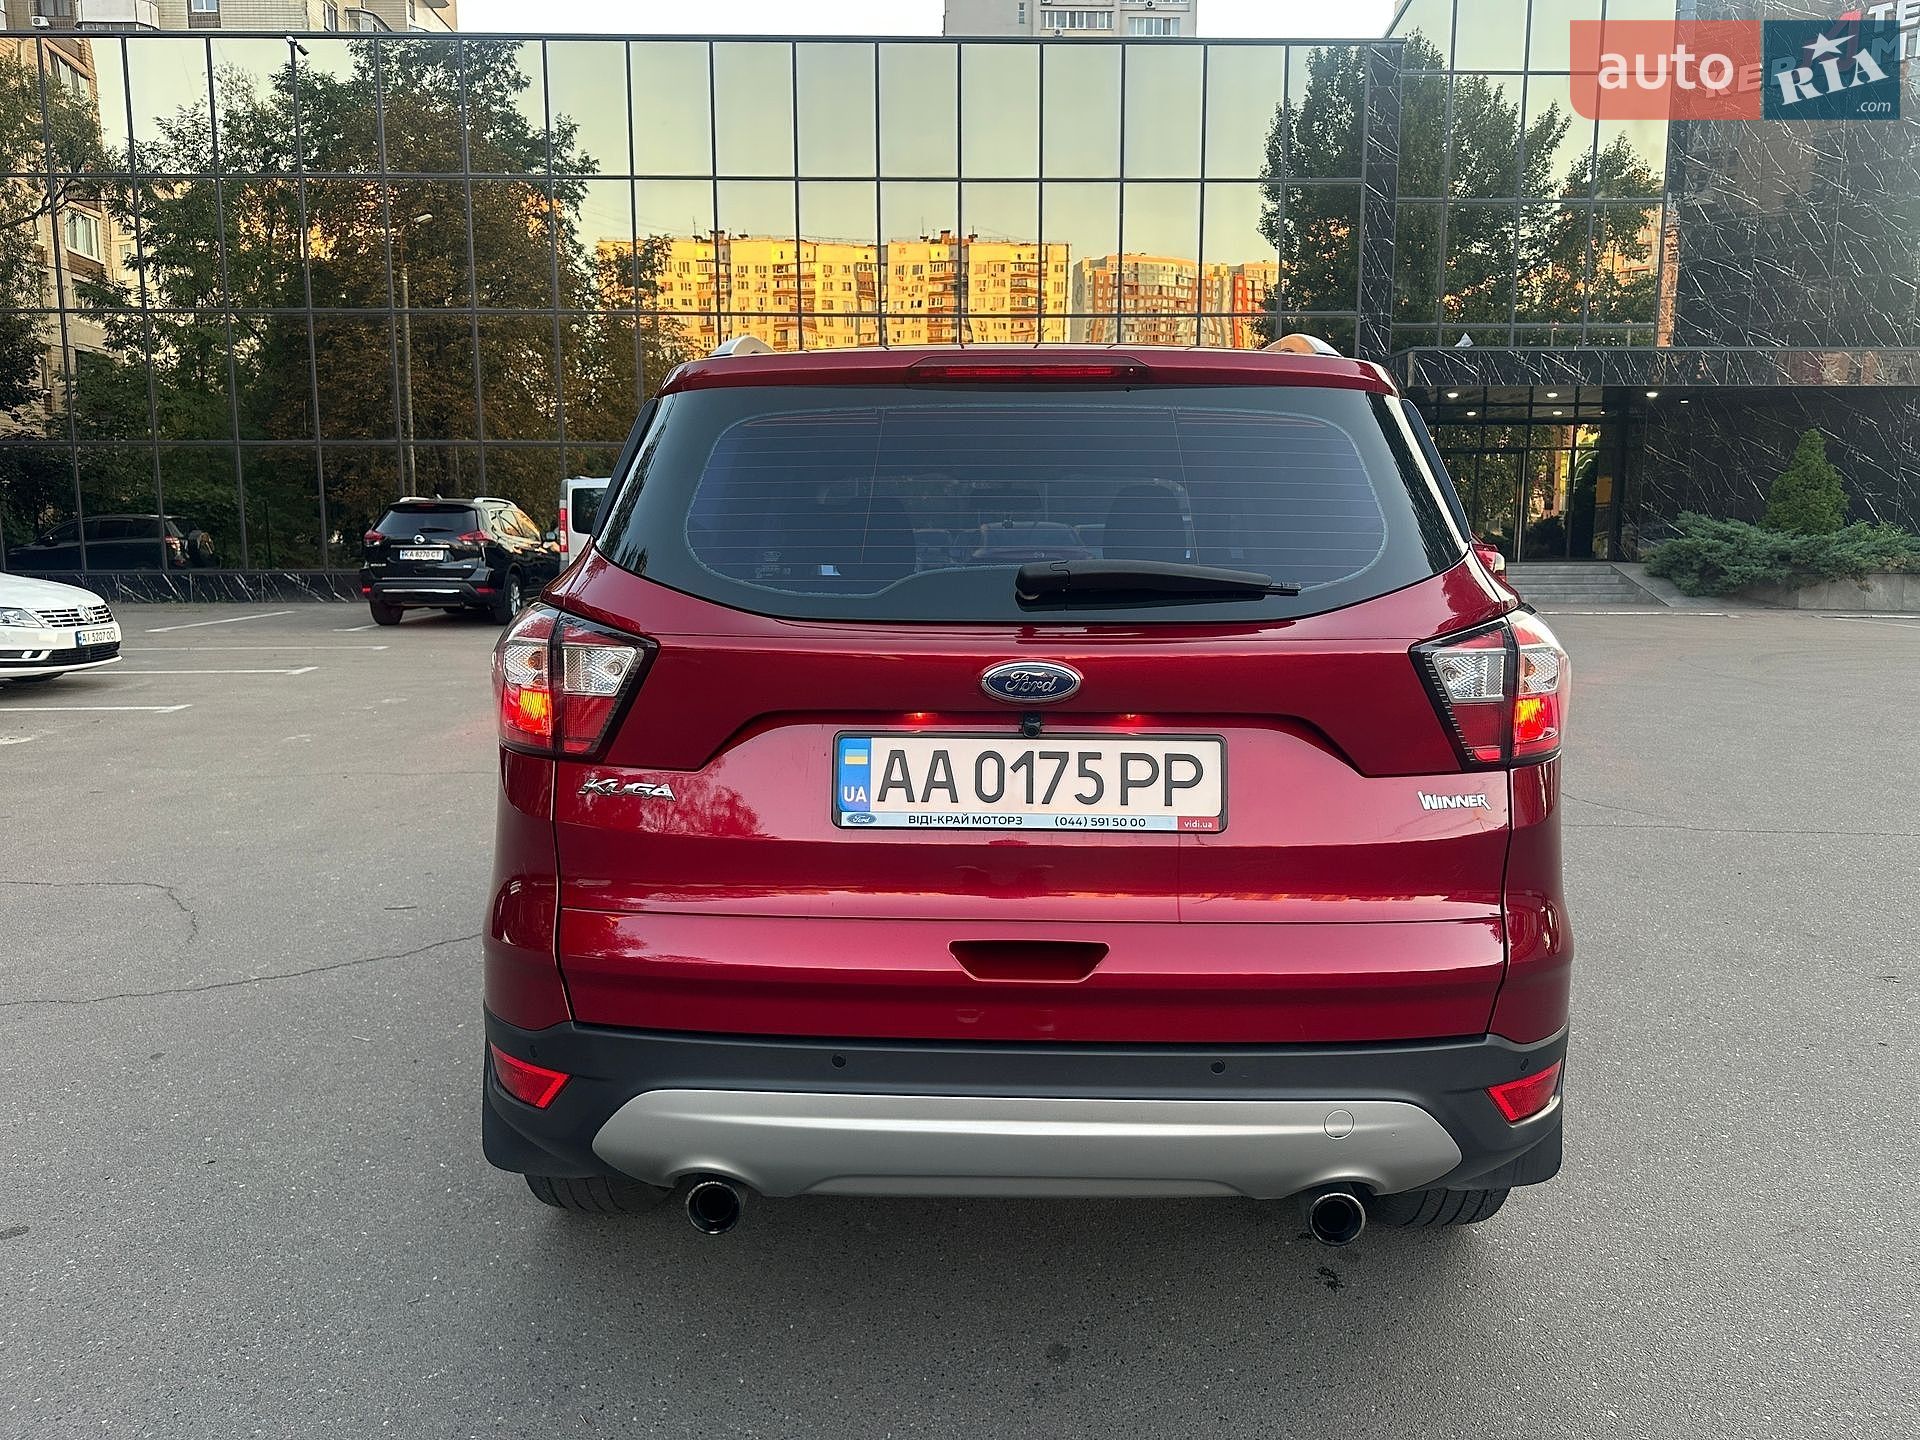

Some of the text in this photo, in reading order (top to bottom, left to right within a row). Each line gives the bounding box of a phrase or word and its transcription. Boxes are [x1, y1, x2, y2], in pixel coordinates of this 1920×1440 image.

[1005, 671, 1057, 692] Ford
[877, 749, 1204, 807] AA 0175 PP
[578, 778, 676, 801] KUGA
[844, 787, 868, 803] UA
[852, 815, 871, 824] Ford
[972, 815, 1023, 825] МОТОРЗ
[1054, 815, 1146, 827] (044) 591 50 00
[1183, 820, 1213, 829] vidi.ua
